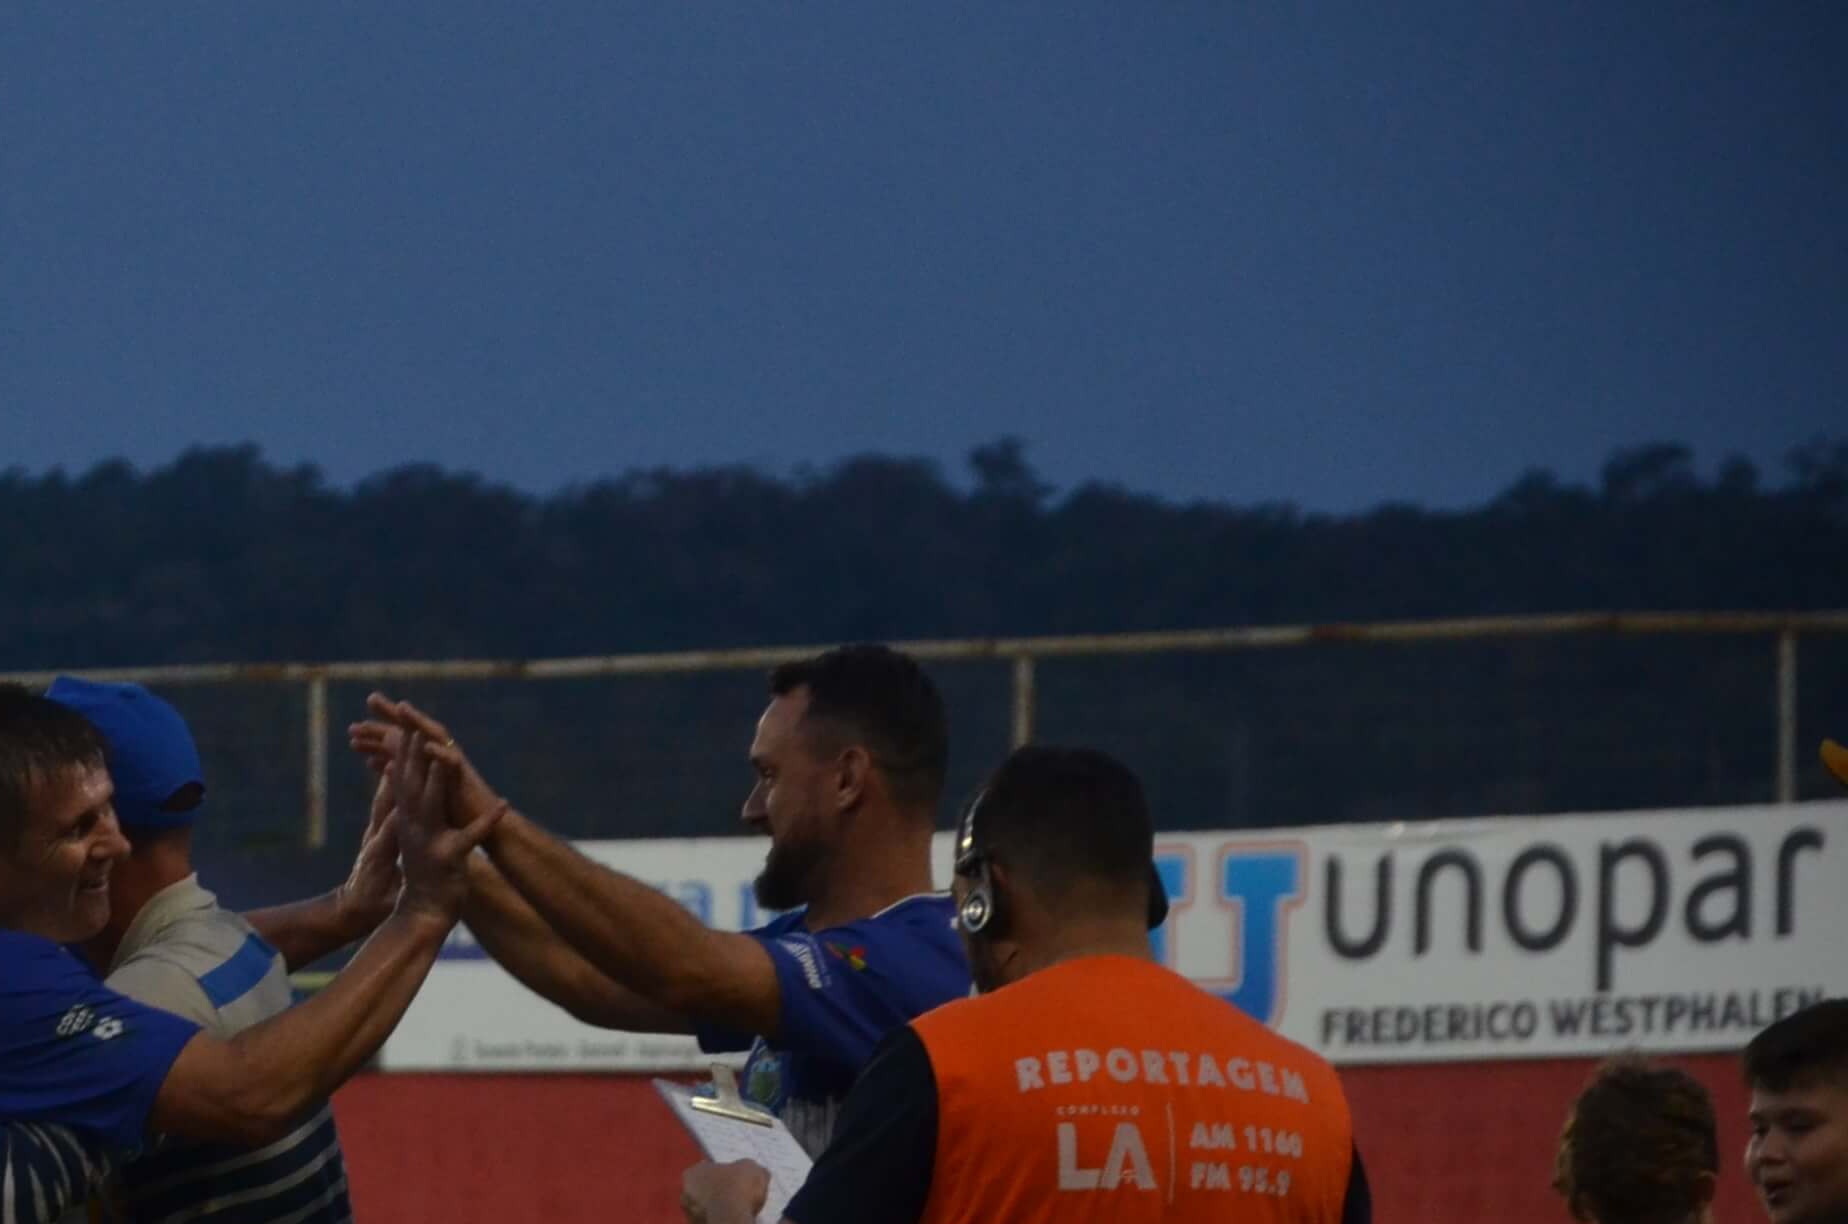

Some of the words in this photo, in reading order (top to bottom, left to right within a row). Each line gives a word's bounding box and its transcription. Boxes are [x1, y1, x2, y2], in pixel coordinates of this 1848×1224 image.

[1324, 828, 1825, 993] unopar
[1322, 1001, 1539, 1046] FREDERICO
[1014, 1047, 1311, 1105] REPORTAGEM
[1056, 1104, 1141, 1117] COMPLEXO
[1055, 1121, 1158, 1192] LA
[1190, 1121, 1236, 1151] AM
[1243, 1124, 1304, 1160] 1160
[1190, 1162, 1231, 1191] FM
